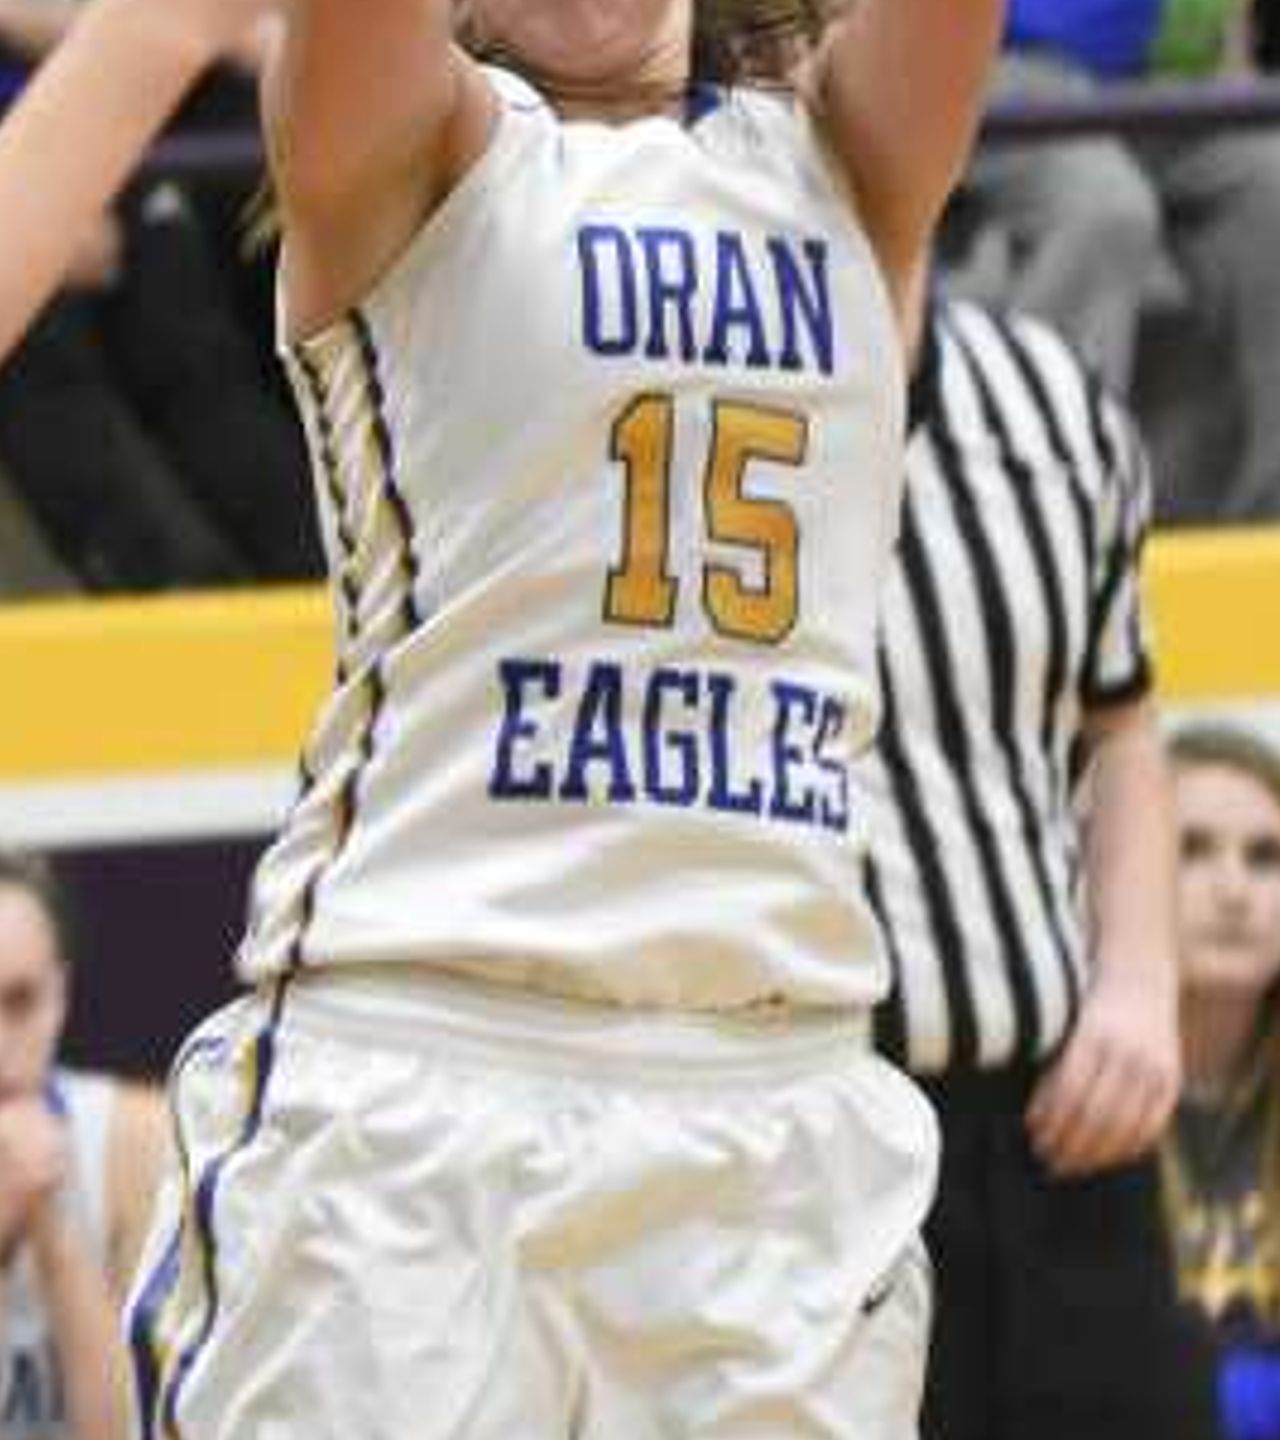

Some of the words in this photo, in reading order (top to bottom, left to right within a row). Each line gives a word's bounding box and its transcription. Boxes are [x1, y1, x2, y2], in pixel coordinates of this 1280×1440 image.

[576, 224, 836, 376] ORAN
[602, 390, 809, 646] 15
[487, 658, 850, 830] EAGLES
